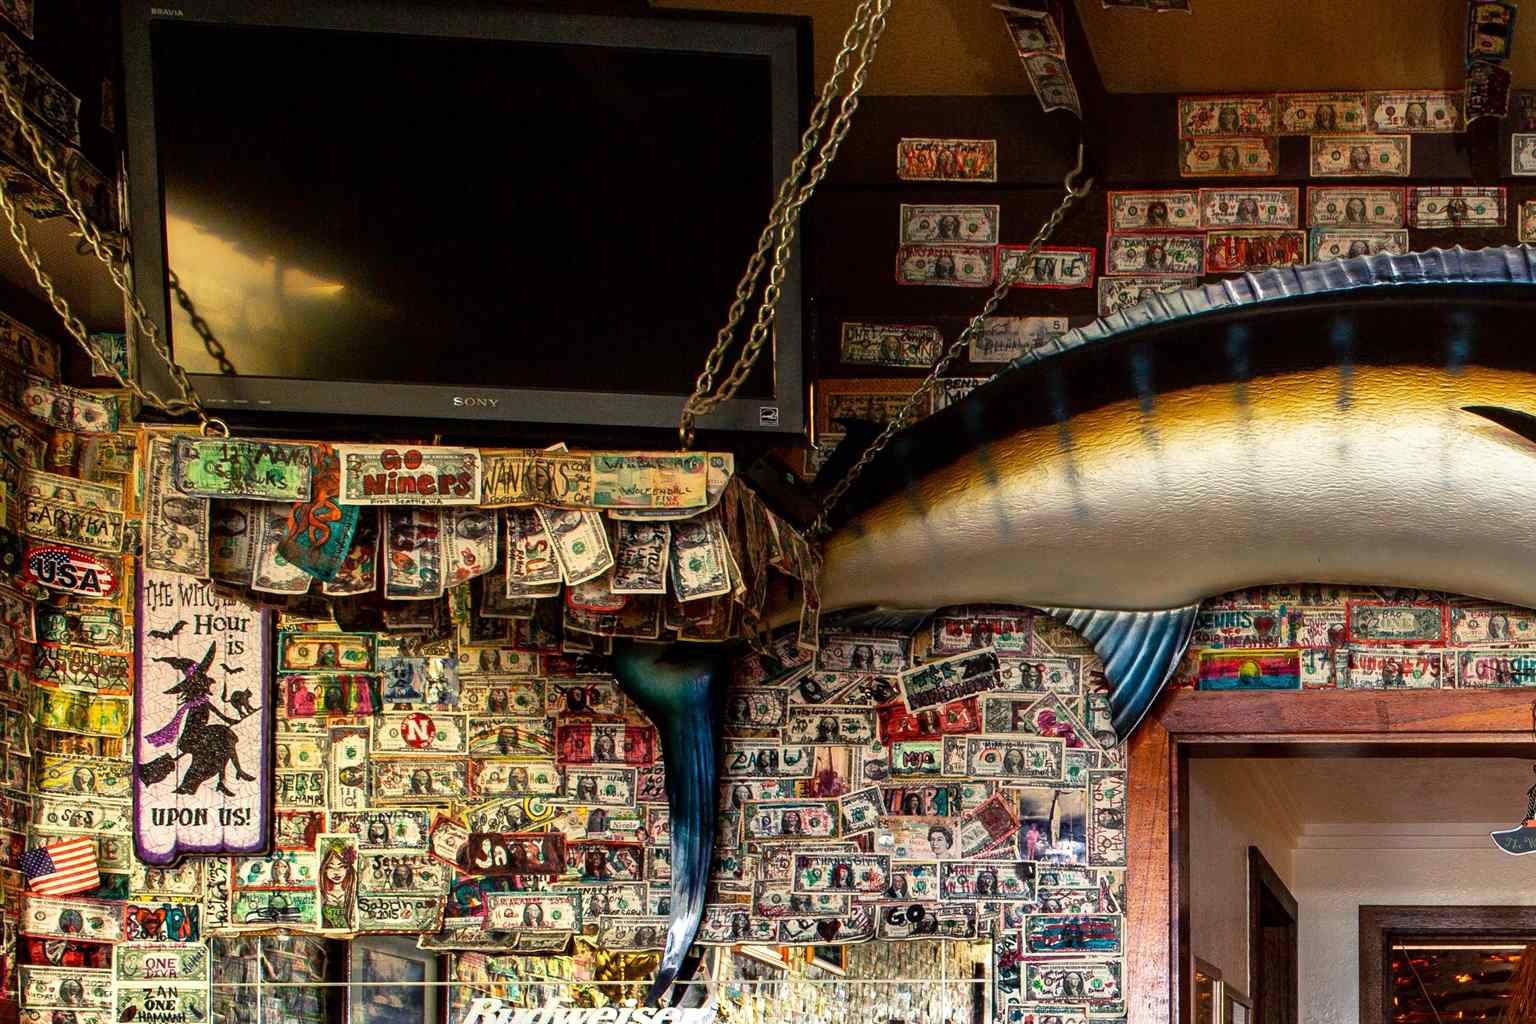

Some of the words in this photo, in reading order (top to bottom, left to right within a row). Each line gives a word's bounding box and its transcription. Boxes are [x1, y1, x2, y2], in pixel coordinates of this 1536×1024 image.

[453, 397, 499, 409] SONY
[380, 449, 423, 470] GO
[363, 471, 472, 496] Niners
[36, 557, 101, 592] USA
[145, 580, 173, 610] THE
[193, 615, 250, 636] Hour
[227, 638, 244, 656] is
[407, 720, 429, 742] N
[151, 808, 208, 827] UPON
[218, 807, 251, 827] US!
[359, 898, 426, 911] Sabrina
[886, 904, 926, 925] GO
[145, 958, 177, 968] ONE
[144, 1000, 176, 1011] ONE
